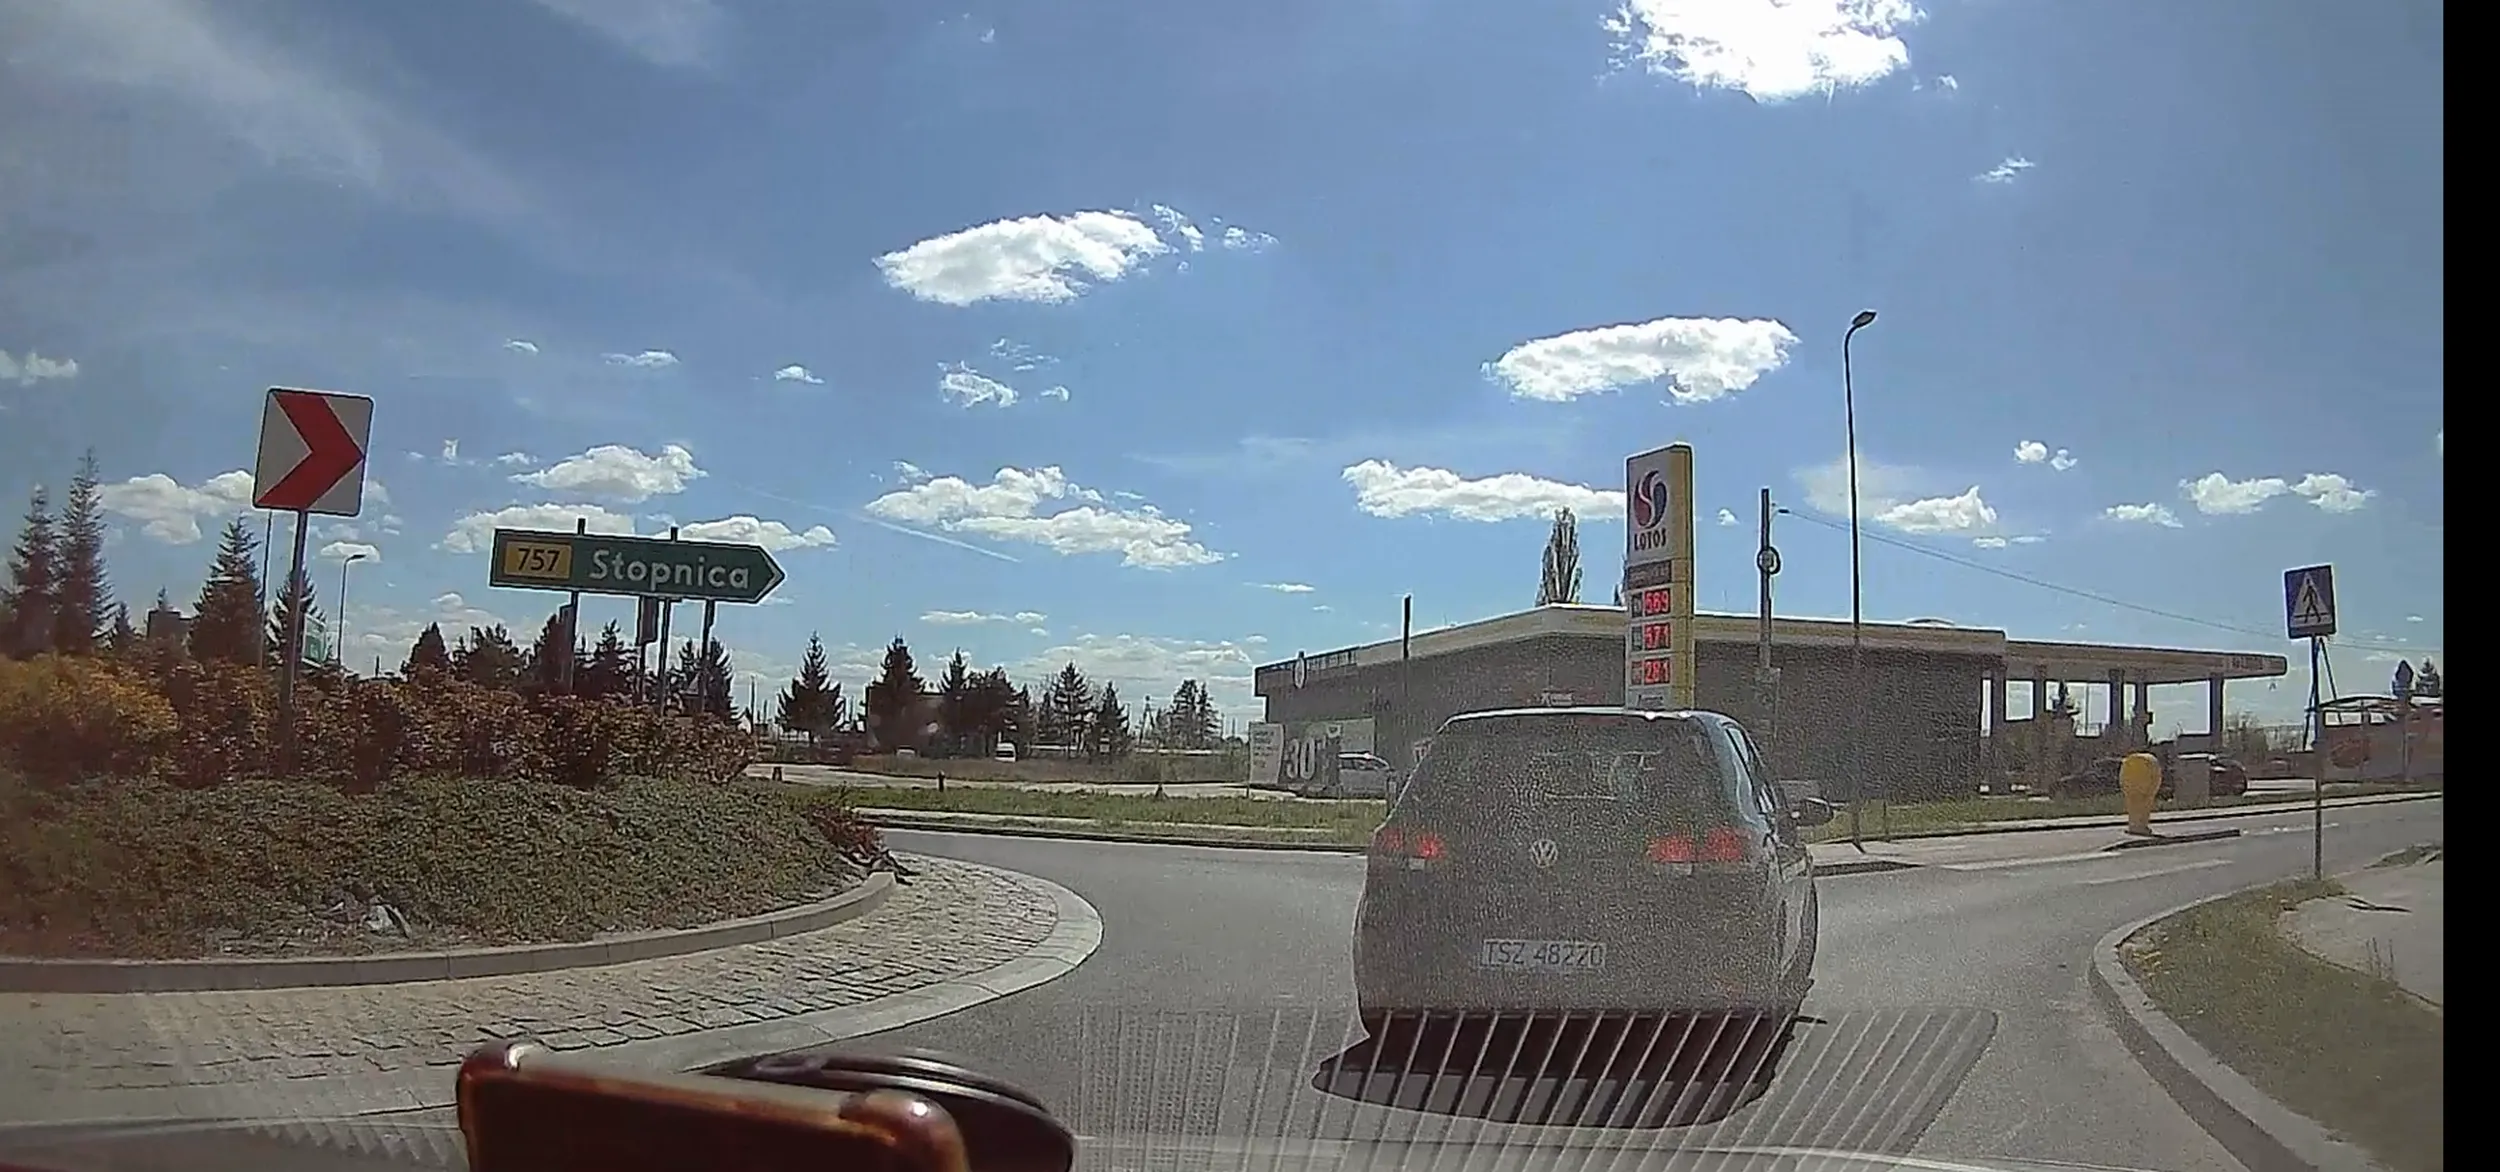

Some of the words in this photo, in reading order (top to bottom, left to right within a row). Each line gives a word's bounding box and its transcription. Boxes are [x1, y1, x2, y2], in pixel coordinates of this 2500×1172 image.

[1634, 528, 1666, 550] LOTOS
[517, 548, 560, 572] 757
[589, 549, 749, 590] Stopnica
